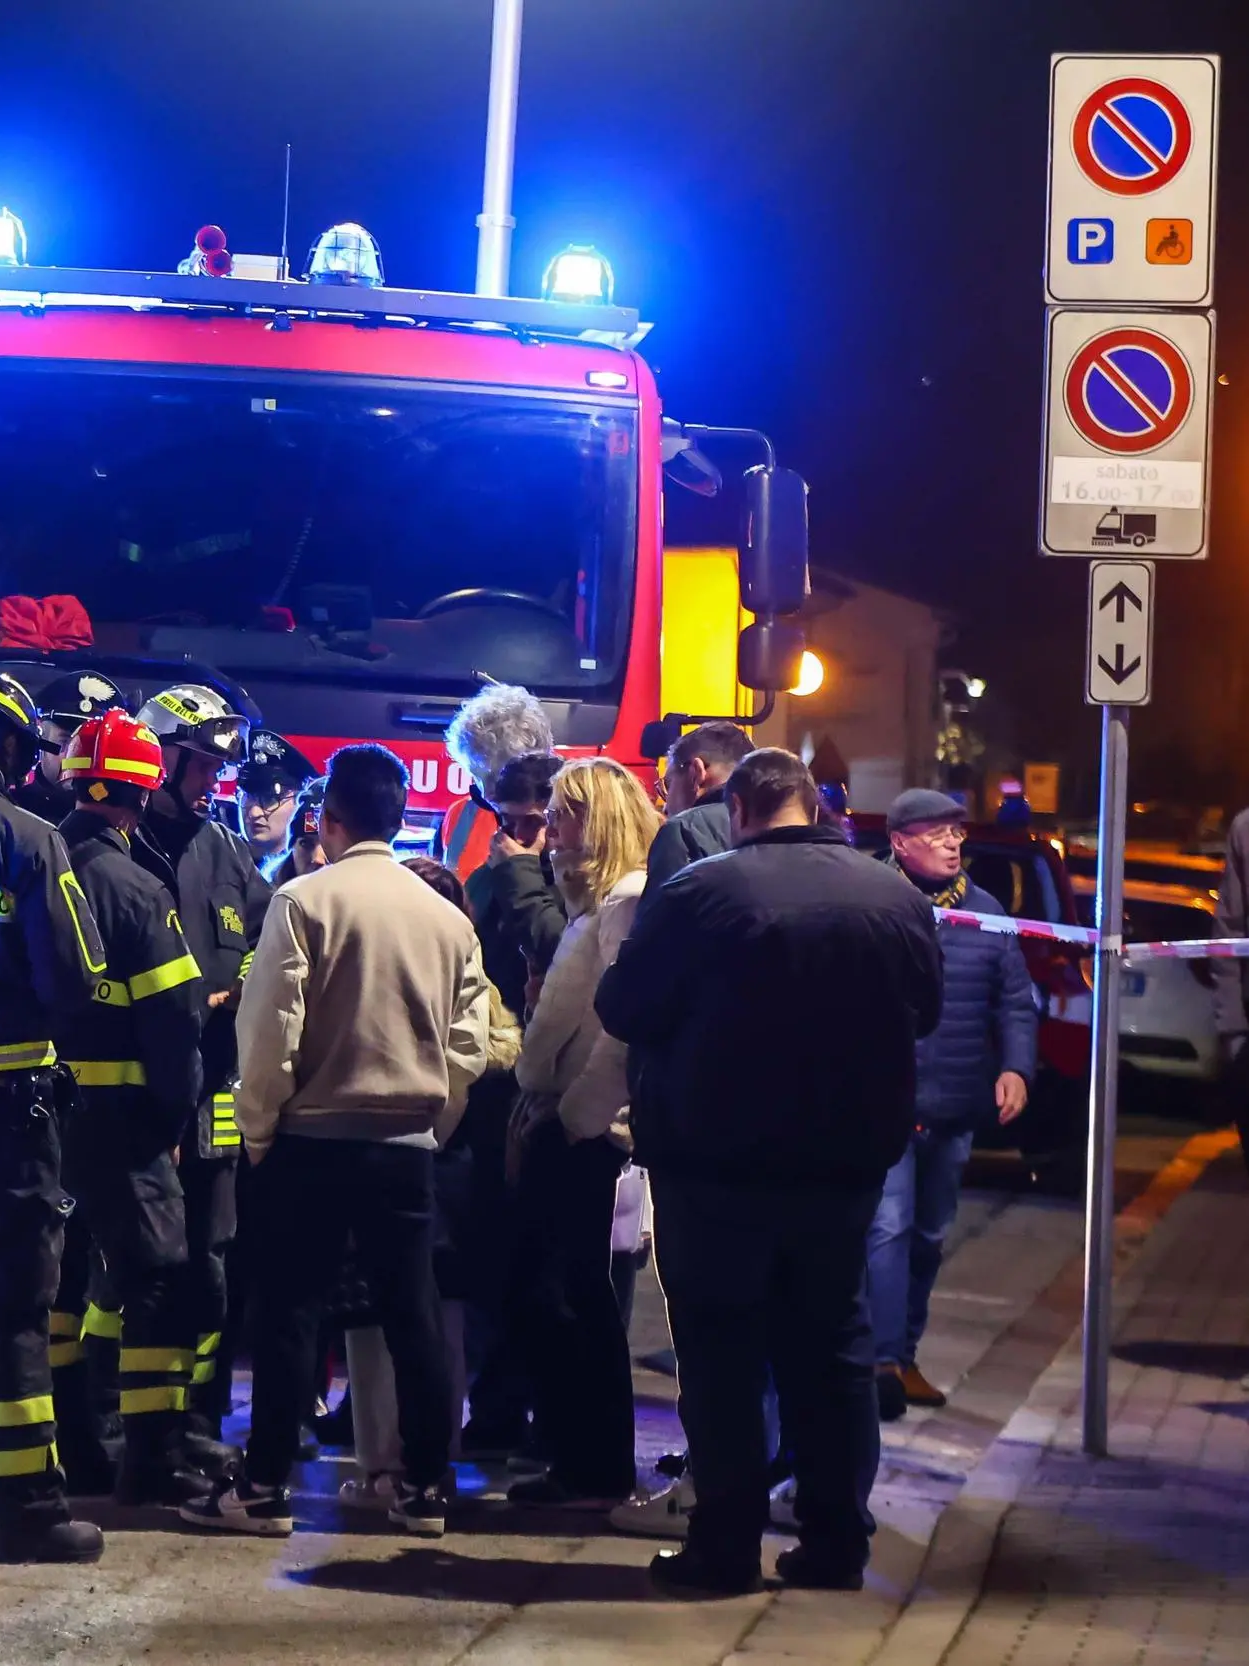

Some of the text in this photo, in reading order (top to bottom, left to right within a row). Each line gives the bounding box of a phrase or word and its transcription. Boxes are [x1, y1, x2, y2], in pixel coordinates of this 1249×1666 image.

[1078, 223, 1106, 260] P
[1095, 463, 1159, 481] sabato
[412, 759, 472, 795] UO
